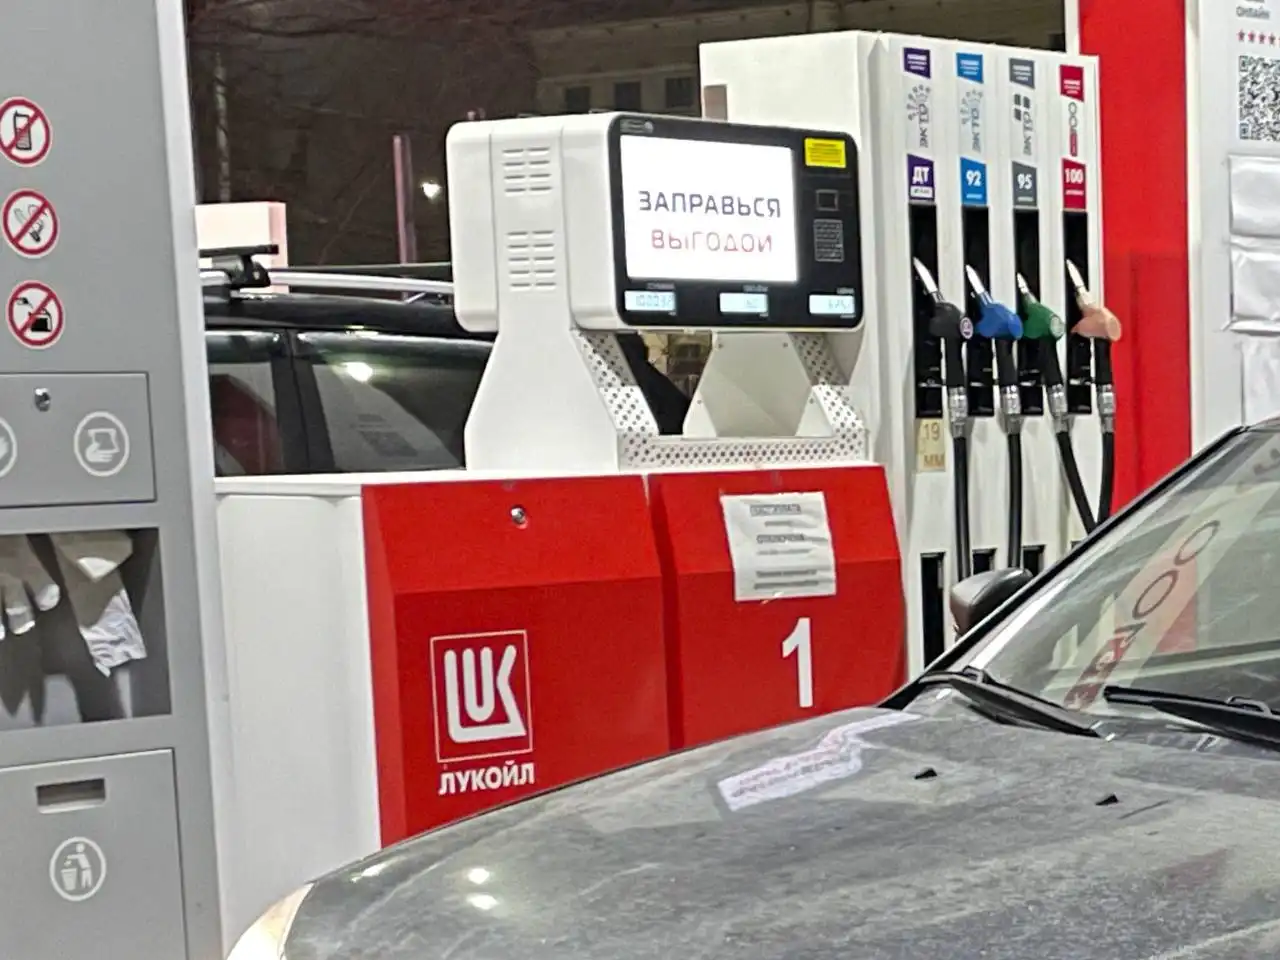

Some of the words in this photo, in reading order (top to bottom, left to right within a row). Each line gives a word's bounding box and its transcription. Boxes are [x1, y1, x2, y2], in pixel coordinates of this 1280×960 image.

[912, 165, 930, 185] ДТ
[965, 169, 982, 187] 92
[1016, 172, 1033, 190] 95
[1064, 167, 1084, 185] 100
[637, 189, 781, 219] ЗАПРАВЬСЯ
[781, 617, 813, 709] 1
[437, 760, 535, 796] ЛУКОЙЛ
